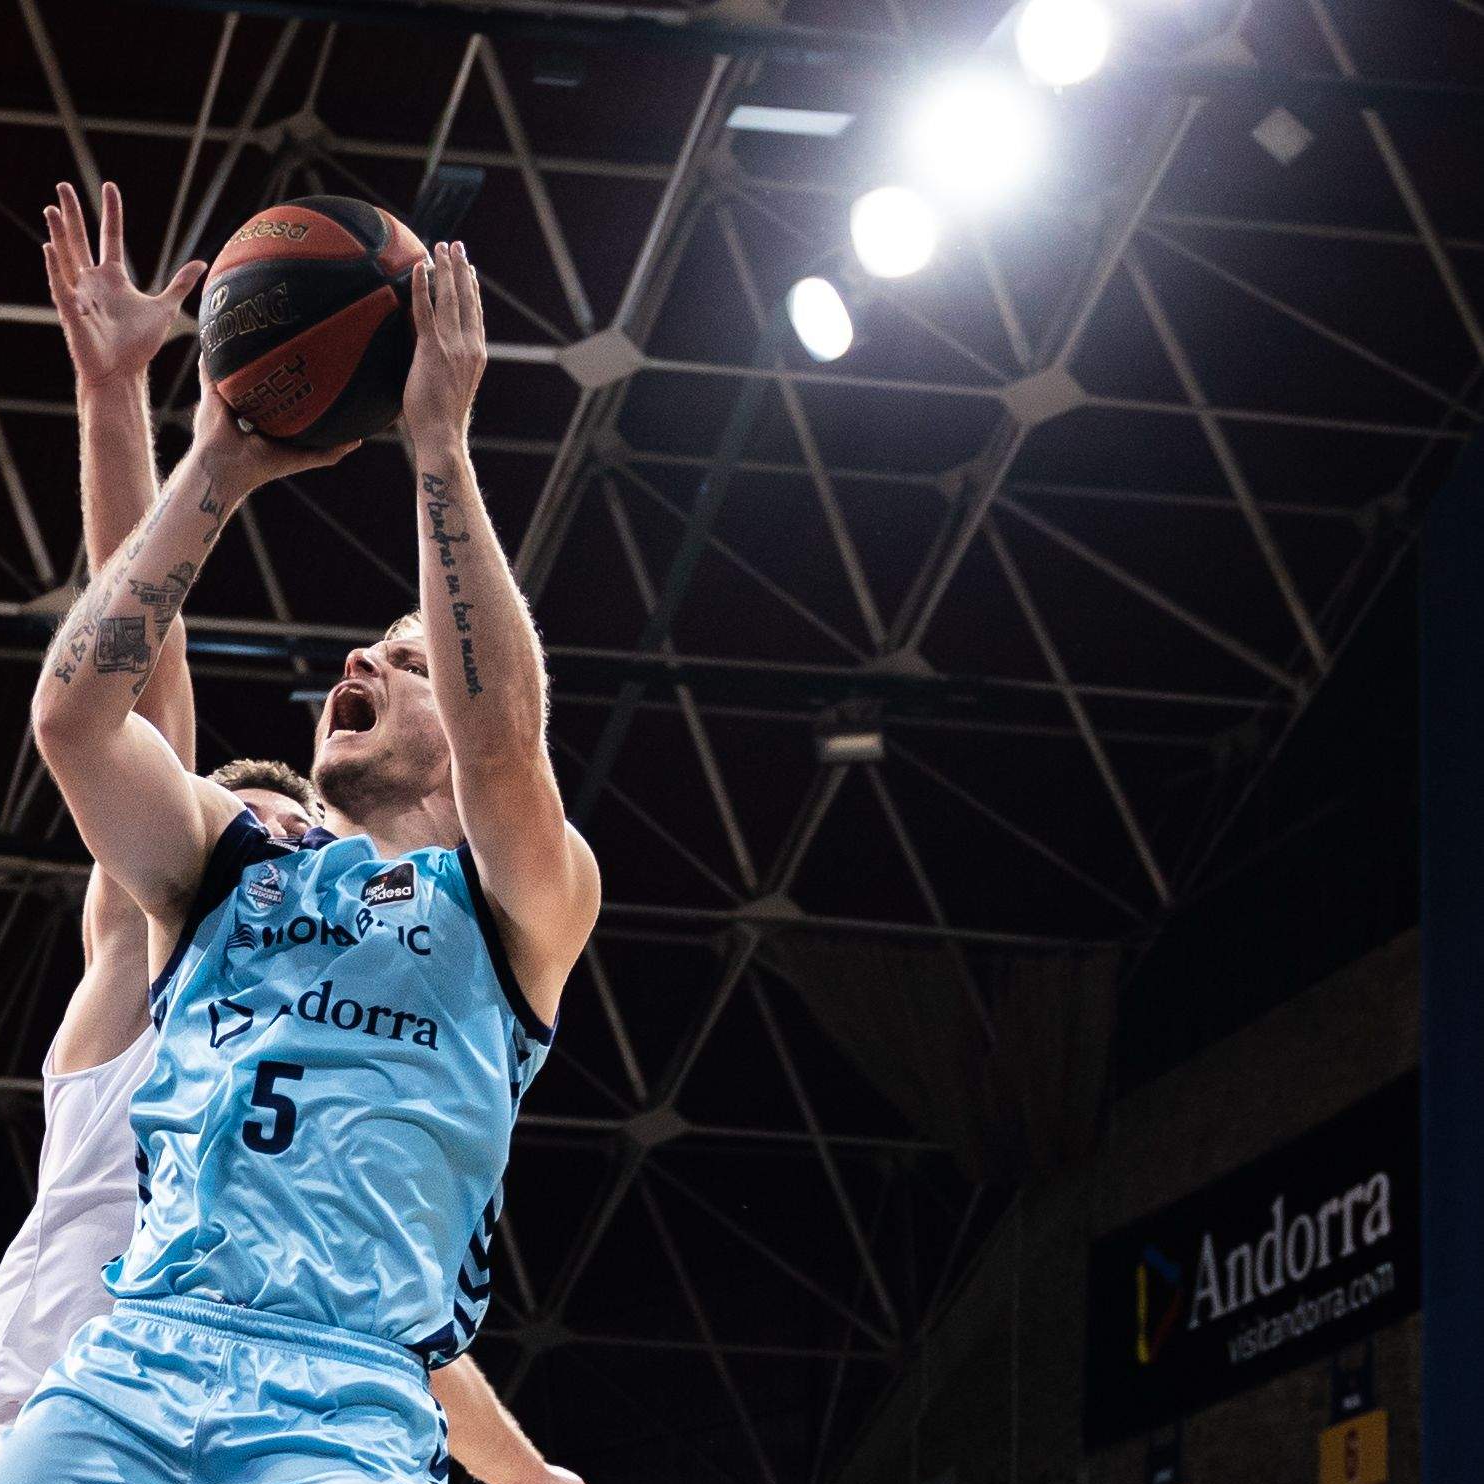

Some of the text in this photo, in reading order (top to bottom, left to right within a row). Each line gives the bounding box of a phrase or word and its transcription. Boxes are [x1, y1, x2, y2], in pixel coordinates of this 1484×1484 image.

[267, 982, 439, 1051] dorra
[242, 1060, 304, 1156] 5
[1187, 1171, 1392, 1330] Andorra
